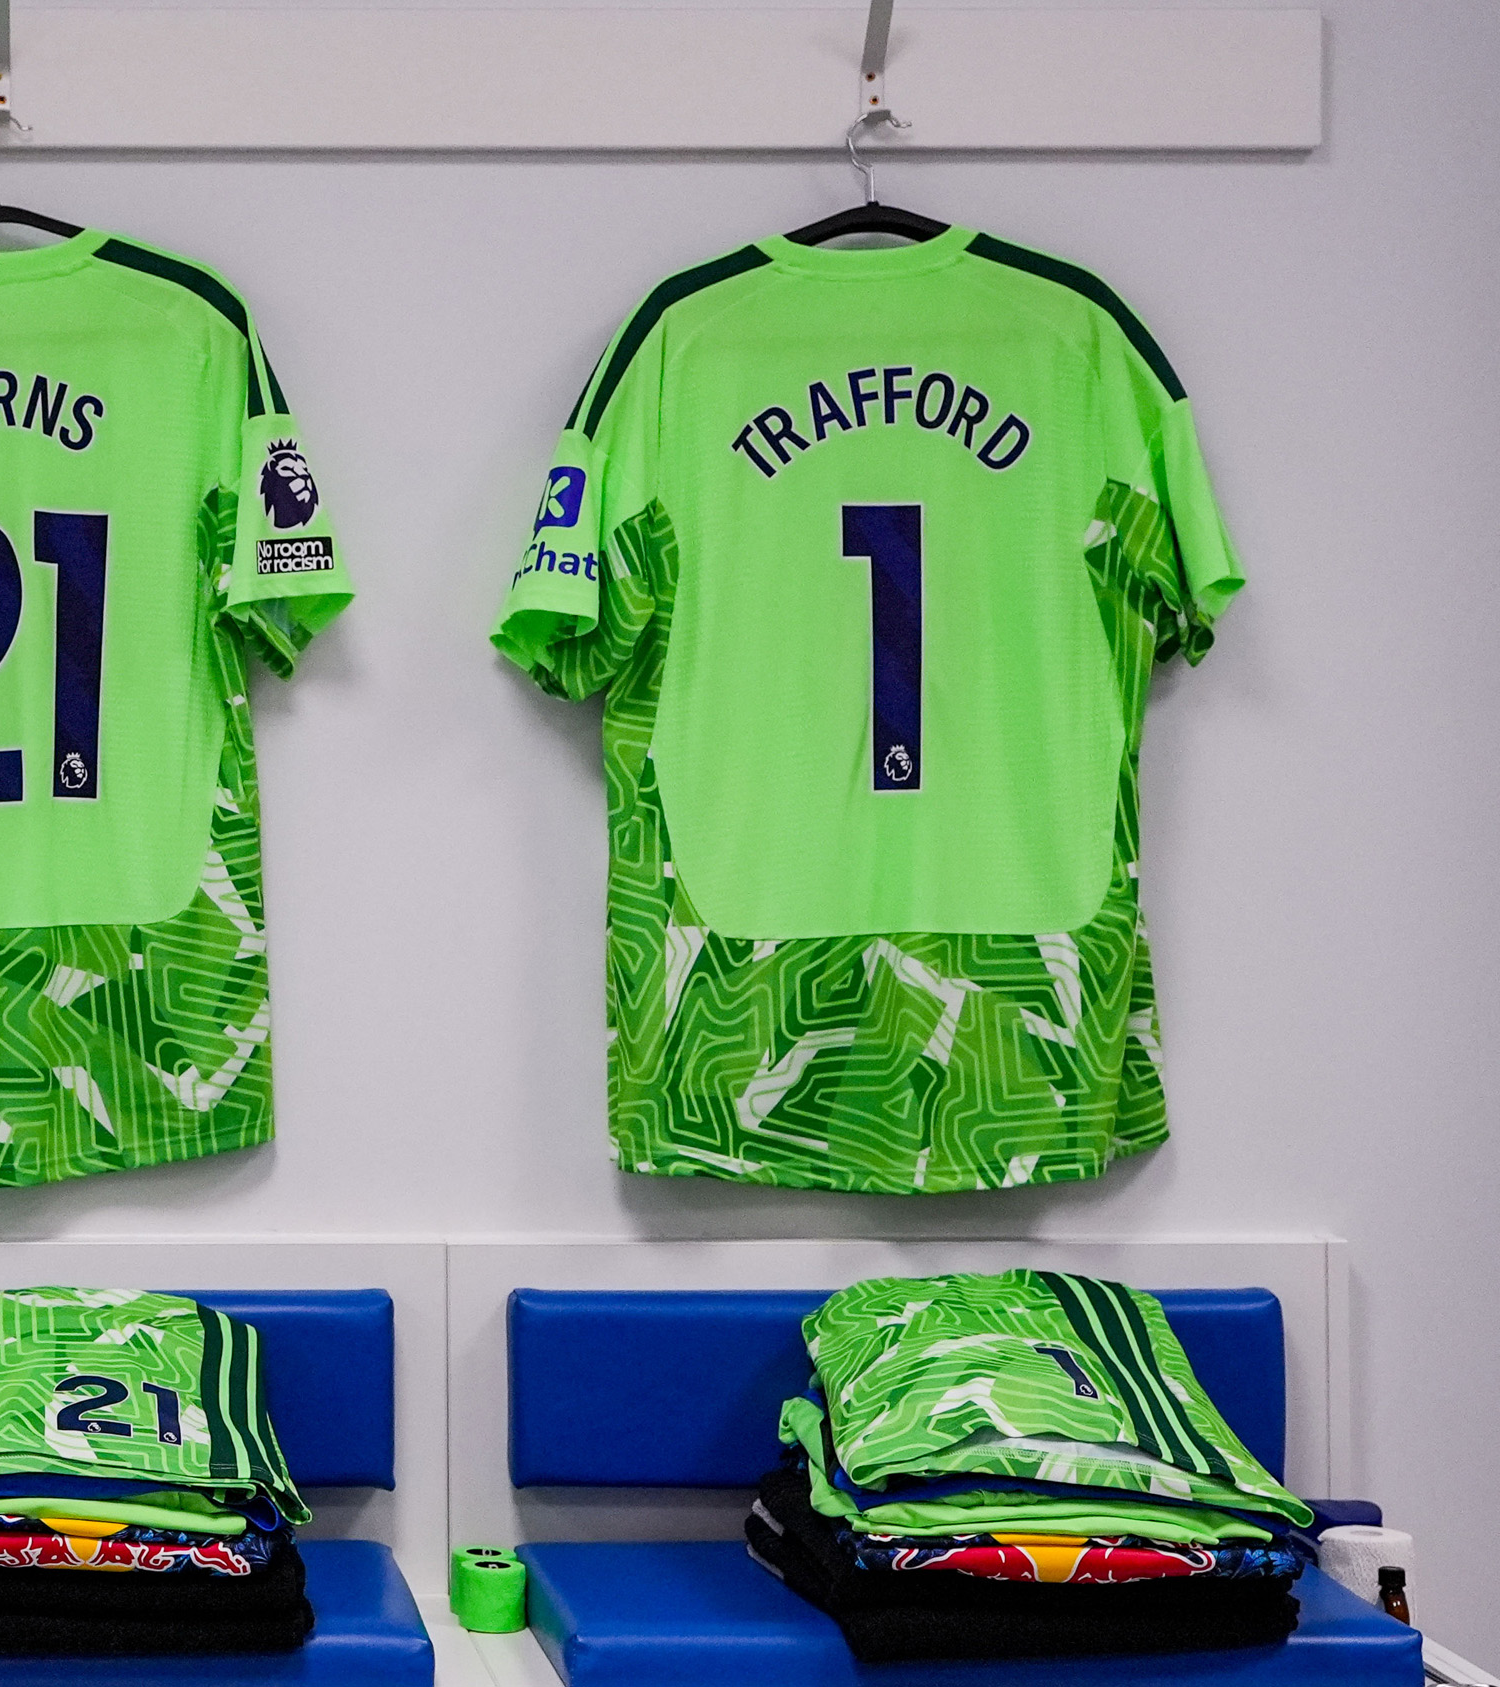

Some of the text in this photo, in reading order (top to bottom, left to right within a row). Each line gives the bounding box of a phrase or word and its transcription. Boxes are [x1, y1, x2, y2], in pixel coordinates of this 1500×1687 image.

[731, 366, 1030, 479] TRAFFORD
[257, 540, 324, 558] No room
[273, 555, 333, 573] racism
[511, 541, 598, 591] Chat
[841, 504, 923, 791] 1
[1034, 1346, 1099, 1399] 1
[53, 1374, 183, 1446] 21
